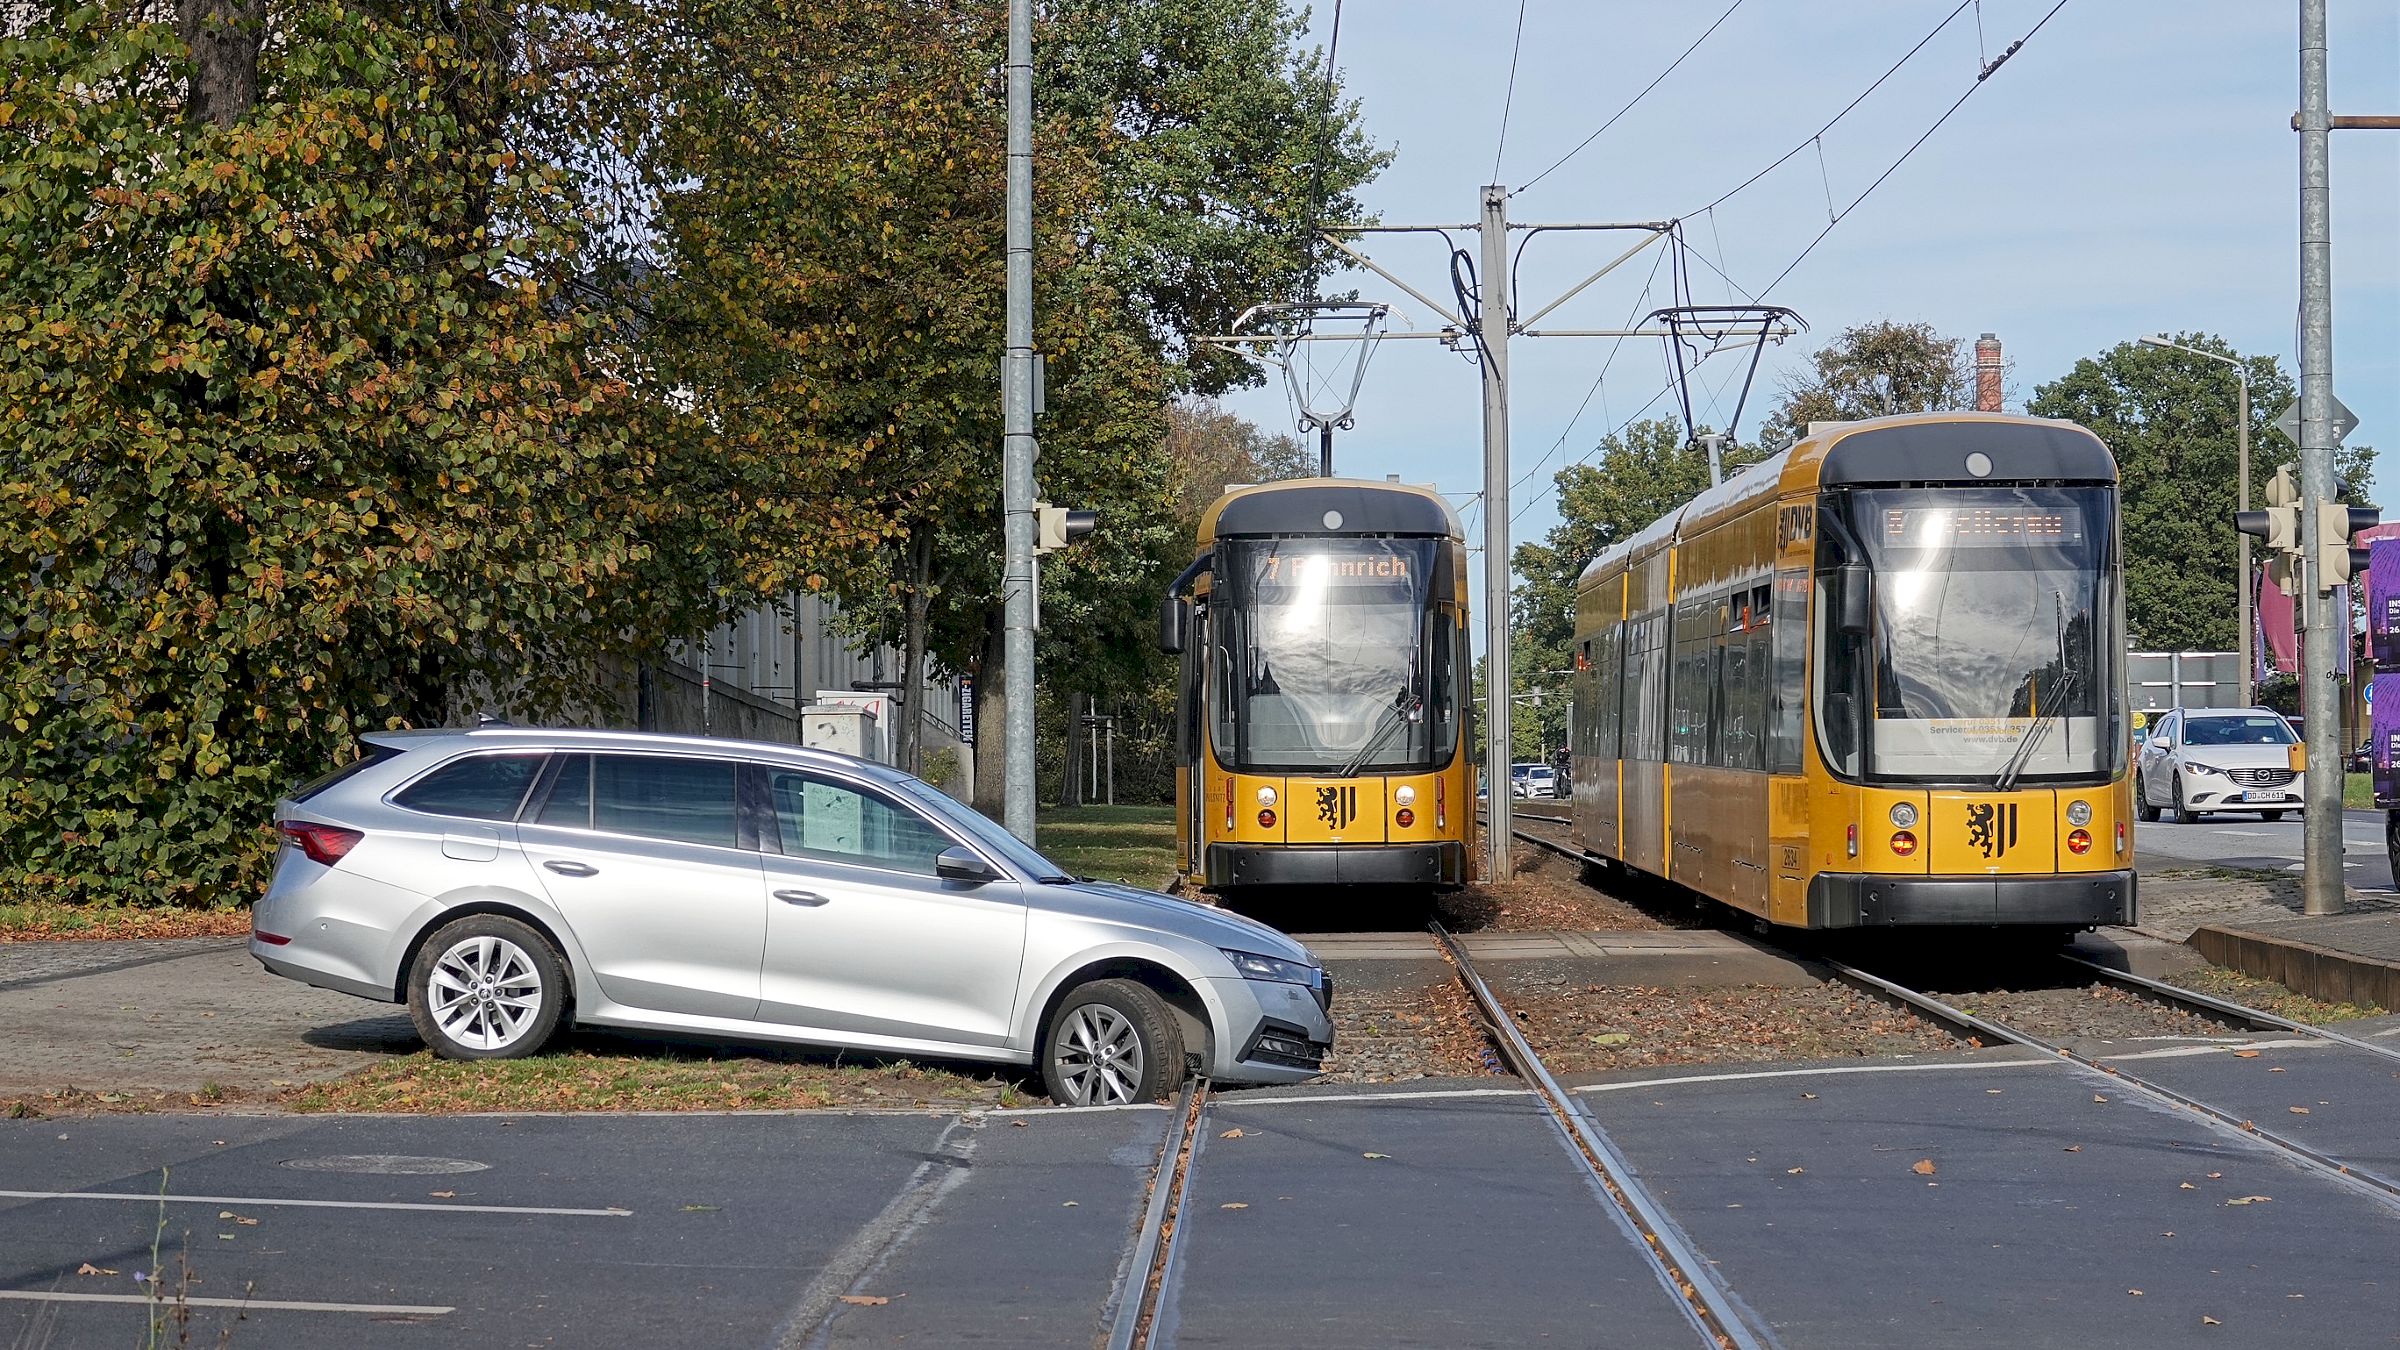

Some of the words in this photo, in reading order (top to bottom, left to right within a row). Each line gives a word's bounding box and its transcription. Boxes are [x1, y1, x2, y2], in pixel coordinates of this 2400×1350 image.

[1790, 505, 1812, 541] DVB
[1268, 557, 1280, 581] 7
[1291, 556, 1406, 577] Pnnrich
[962, 680, 974, 742] E-ZIGARETTEN
[1930, 725, 1976, 735] Serviceruf
[1963, 735, 2018, 743] www.dvb.de
